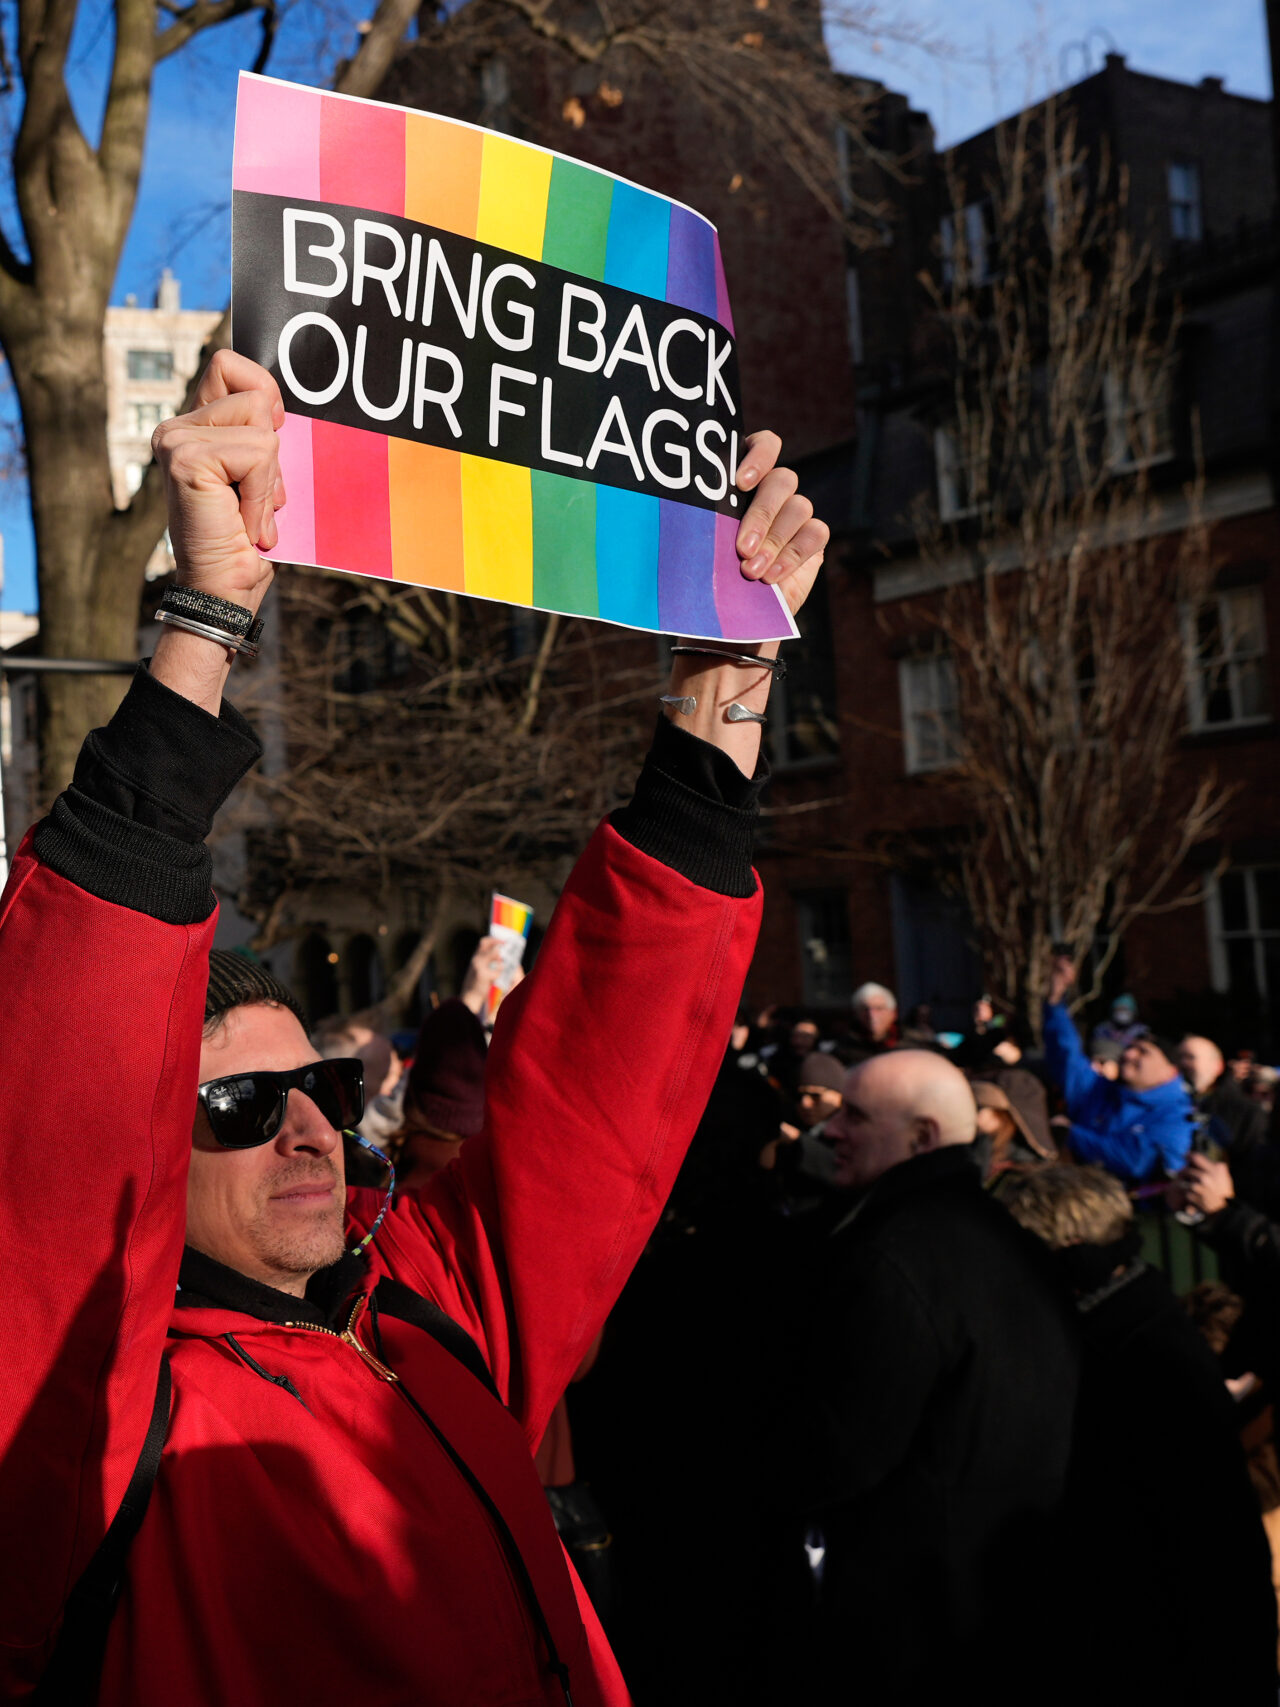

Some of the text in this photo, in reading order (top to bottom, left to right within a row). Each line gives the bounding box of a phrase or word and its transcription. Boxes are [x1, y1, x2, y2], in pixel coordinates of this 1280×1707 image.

[278, 311, 739, 507] OUR FLAGS!
[283, 208, 736, 416] BRING BACK
